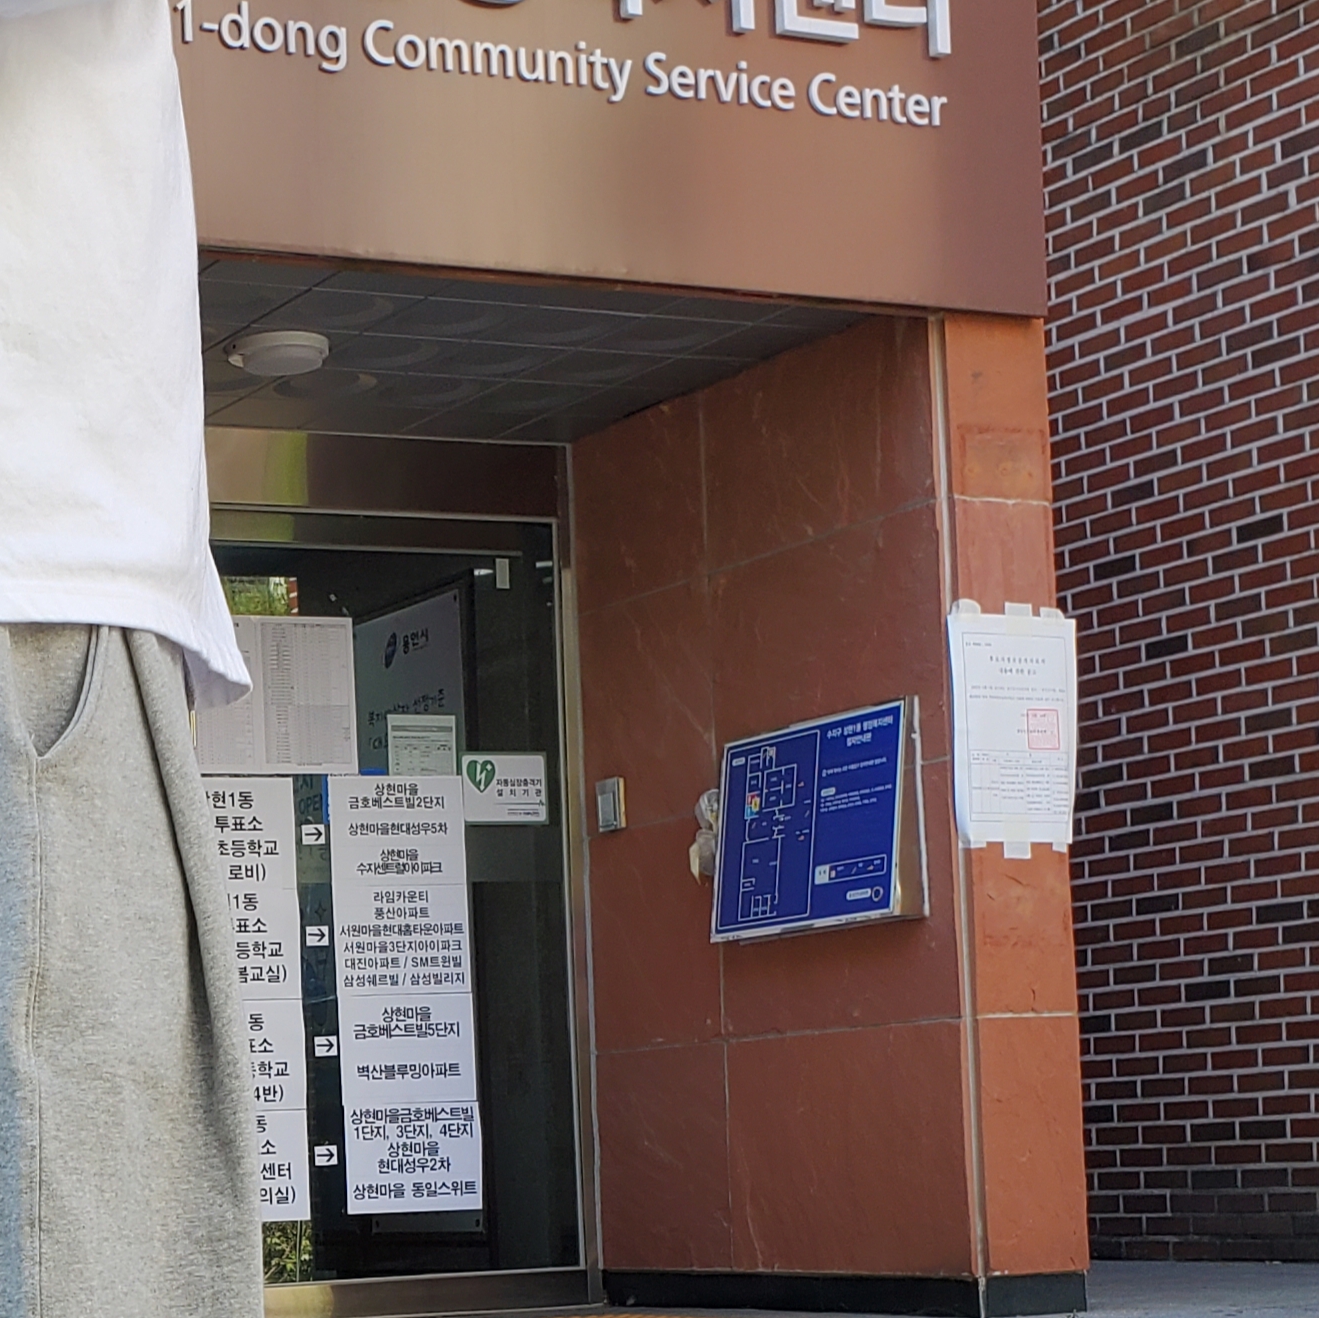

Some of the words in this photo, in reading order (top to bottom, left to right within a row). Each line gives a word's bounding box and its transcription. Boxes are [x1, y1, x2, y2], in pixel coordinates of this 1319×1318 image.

[173, 0, 347, 73] 1-dong
[363, 19, 632, 102] Community
[643, 52, 796, 110] Service
[808, 72, 948, 127] Center
[402, 627, 429, 655] 용인시
[374, 783, 419, 796] 상현마을
[206, 790, 254, 809] 현1동
[348, 796, 445, 809] 금호베스트빌2단지
[214, 816, 263, 833] 투표소
[348, 822, 448, 836] 상현마을현대성우5차
[380, 849, 419, 862] 상현마을
[228, 862, 267, 882] 로비)
[227, 893, 258, 912] 1동
[373, 890, 429, 904] 라임카운티
[374, 906, 430, 920] 풍산아파트
[231, 918, 267, 934] 표소
[340, 922, 464, 938] 서원마을현대홈타운아파트
[235, 940, 284, 960] 등학교
[344, 939, 463, 954] 서원마을3단지아이파크
[345, 956, 401, 970] 대진아파트
[411, 955, 462, 969] SM트윈빌
[343, 973, 399, 987] 삼성쉐르빌
[409, 971, 465, 986] 삼성빌리지
[248, 1013, 264, 1031] 동
[382, 1006, 432, 1023] 상현마을
[353, 1021, 460, 1039] 금호베스트빌5단지
[251, 1061, 290, 1079] 학교
[357, 1062, 461, 1080] 벽산블루밍아파트
[350, 1106, 475, 1124] 상현마을금호베스트빌
[354, 1125, 390, 1140] 1단지,
[396, 1124, 432, 1140] 3단지,
[439, 1122, 474, 1138] 4단지
[387, 1141, 440, 1158] 상현마을
[260, 1162, 292, 1180] 센터
[378, 1157, 451, 1174] 현대성우2차
[260, 1185, 296, 1205] 의실)
[353, 1182, 405, 1200] 상현마을
[411, 1180, 477, 1198] 동일스위트
